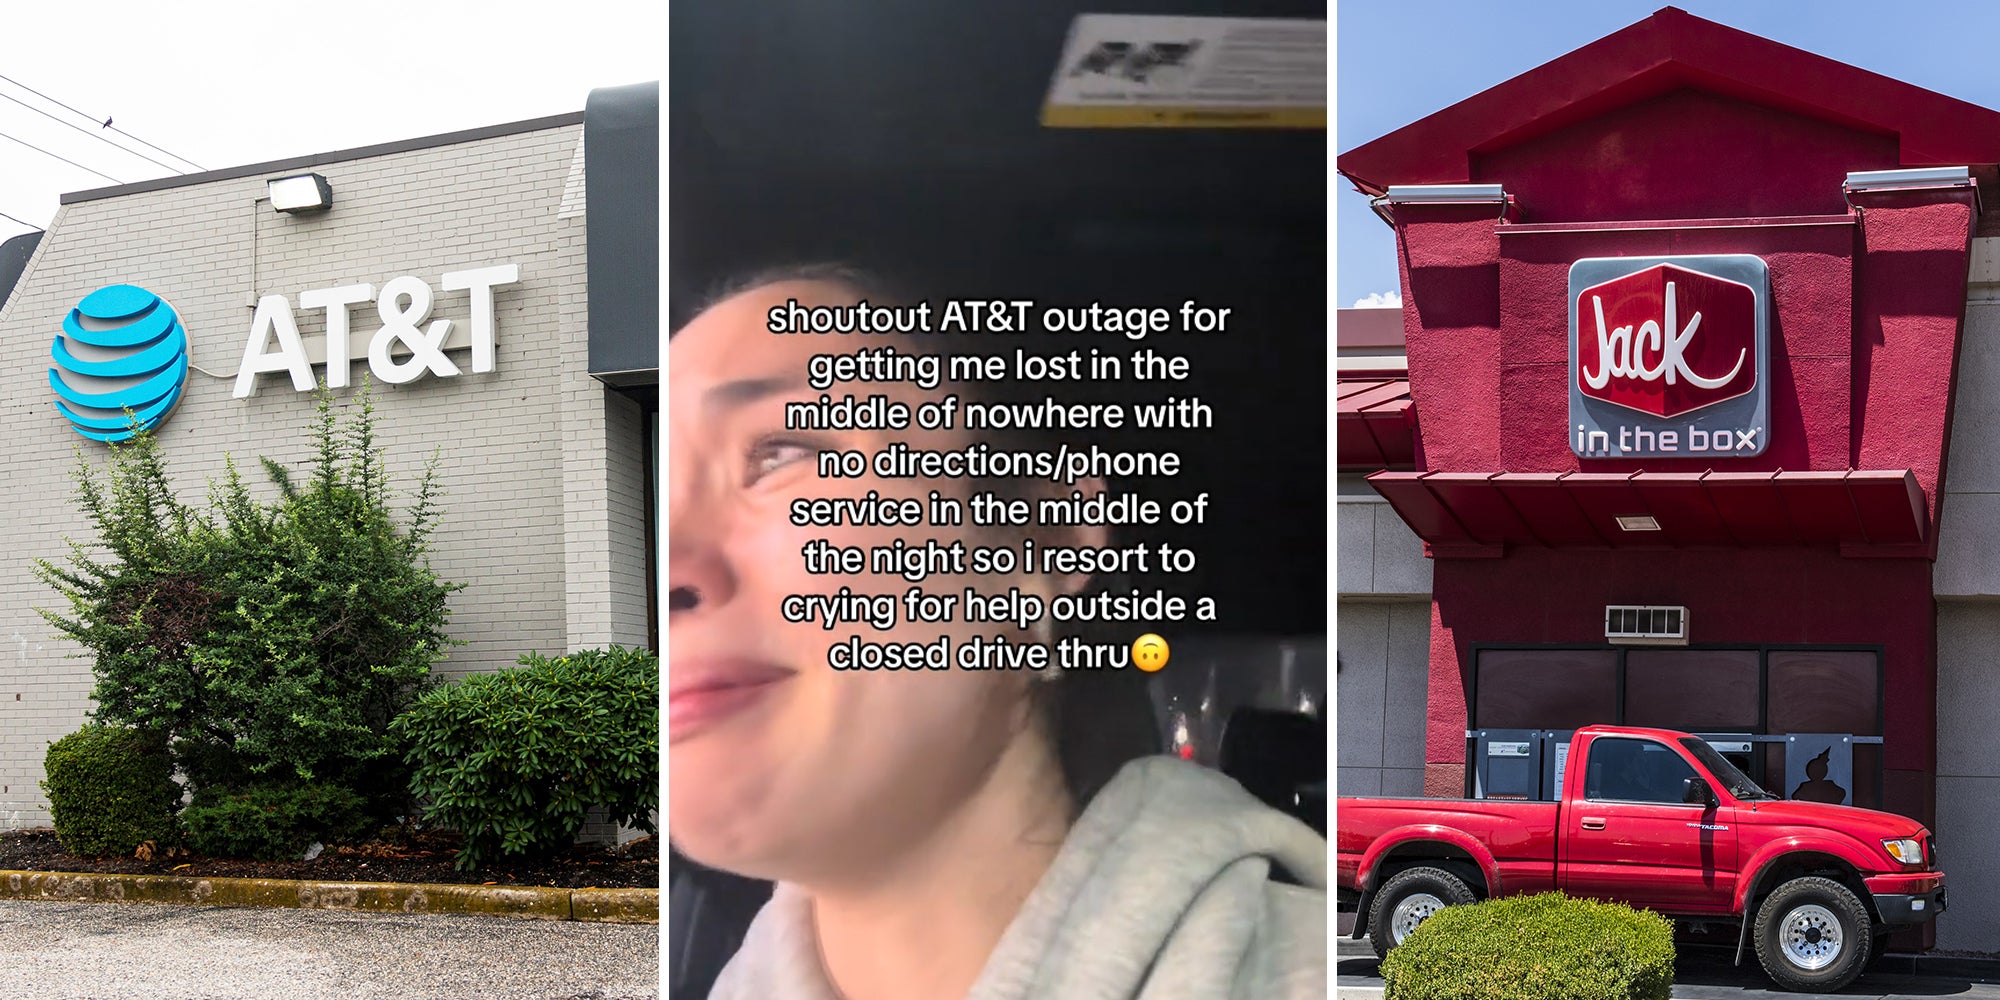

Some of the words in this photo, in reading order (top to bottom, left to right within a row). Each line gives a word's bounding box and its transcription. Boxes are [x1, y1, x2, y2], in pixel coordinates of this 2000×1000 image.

[231, 263, 519, 399] AT&T
[1582, 281, 1747, 390] Jack
[1577, 424, 1609, 453] in
[1619, 425, 1679, 453] the
[1688, 424, 1757, 452] box
